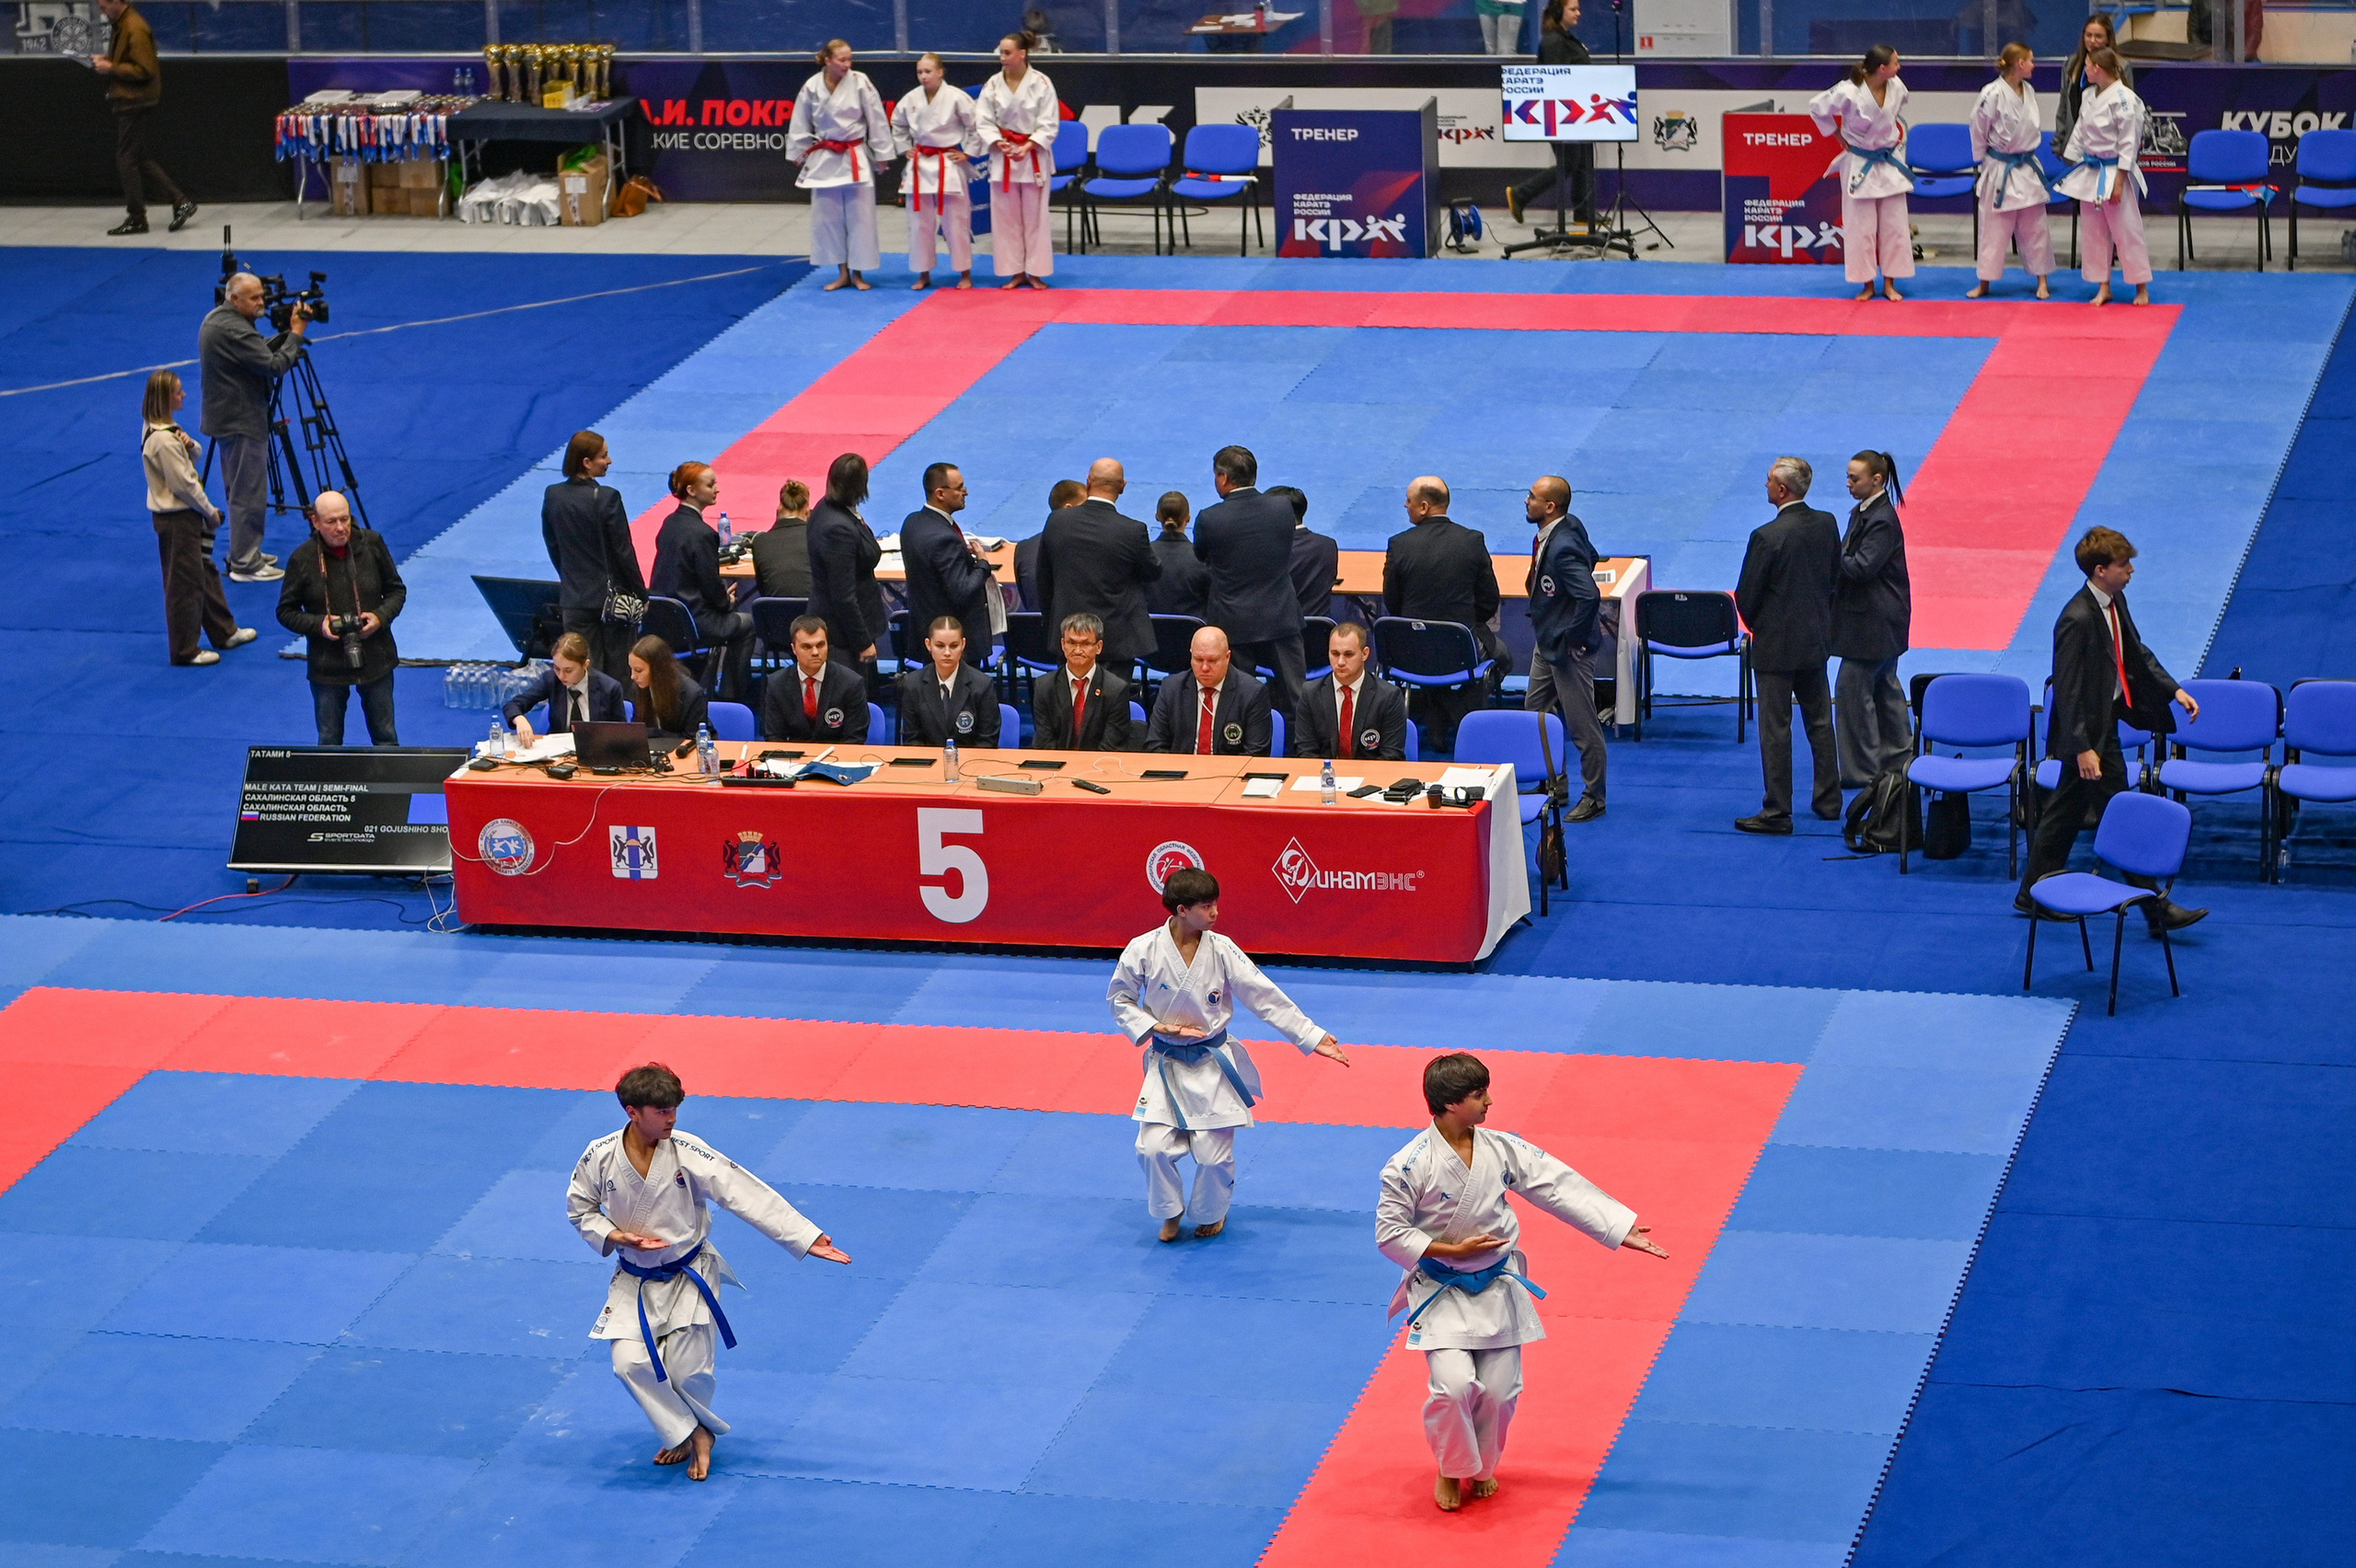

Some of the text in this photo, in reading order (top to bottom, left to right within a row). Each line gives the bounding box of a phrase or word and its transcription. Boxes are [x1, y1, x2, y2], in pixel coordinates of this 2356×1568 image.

[701, 99, 797, 126] ПОКР
[2221, 110, 2347, 138] КУБОК
[1290, 128, 1359, 141] ТРЕНЕР
[1743, 133, 1813, 146] ТРЕНЕР
[653, 133, 789, 150] КИЕ СОРЕВНО
[2269, 144, 2298, 167] ДУ
[1293, 193, 1353, 202] ФЕДЕРАЦИЯ
[1744, 200, 1805, 208] ФЕДЕРАЦИЯ
[1293, 208, 1332, 216] РОССИИ
[1744, 214, 1783, 223] РОССИИ
[250, 750, 292, 758] ТАТАМИ 5
[245, 783, 369, 792] MALE KATA TEAM SEMI-FINAL
[245, 793, 356, 803] САХАЛИНСКАЯ ОБЛАСТЬ 5
[243, 803, 347, 813] САХАЛИНСКАЯ ОБЛАСТЬ
[260, 813, 352, 822] RUSSIAN FEDERATION
[364, 824, 449, 834] 021 GOJUSHIHO SHO
[917, 807, 989, 924] 5
[689, 1145, 715, 1161] SPORT
